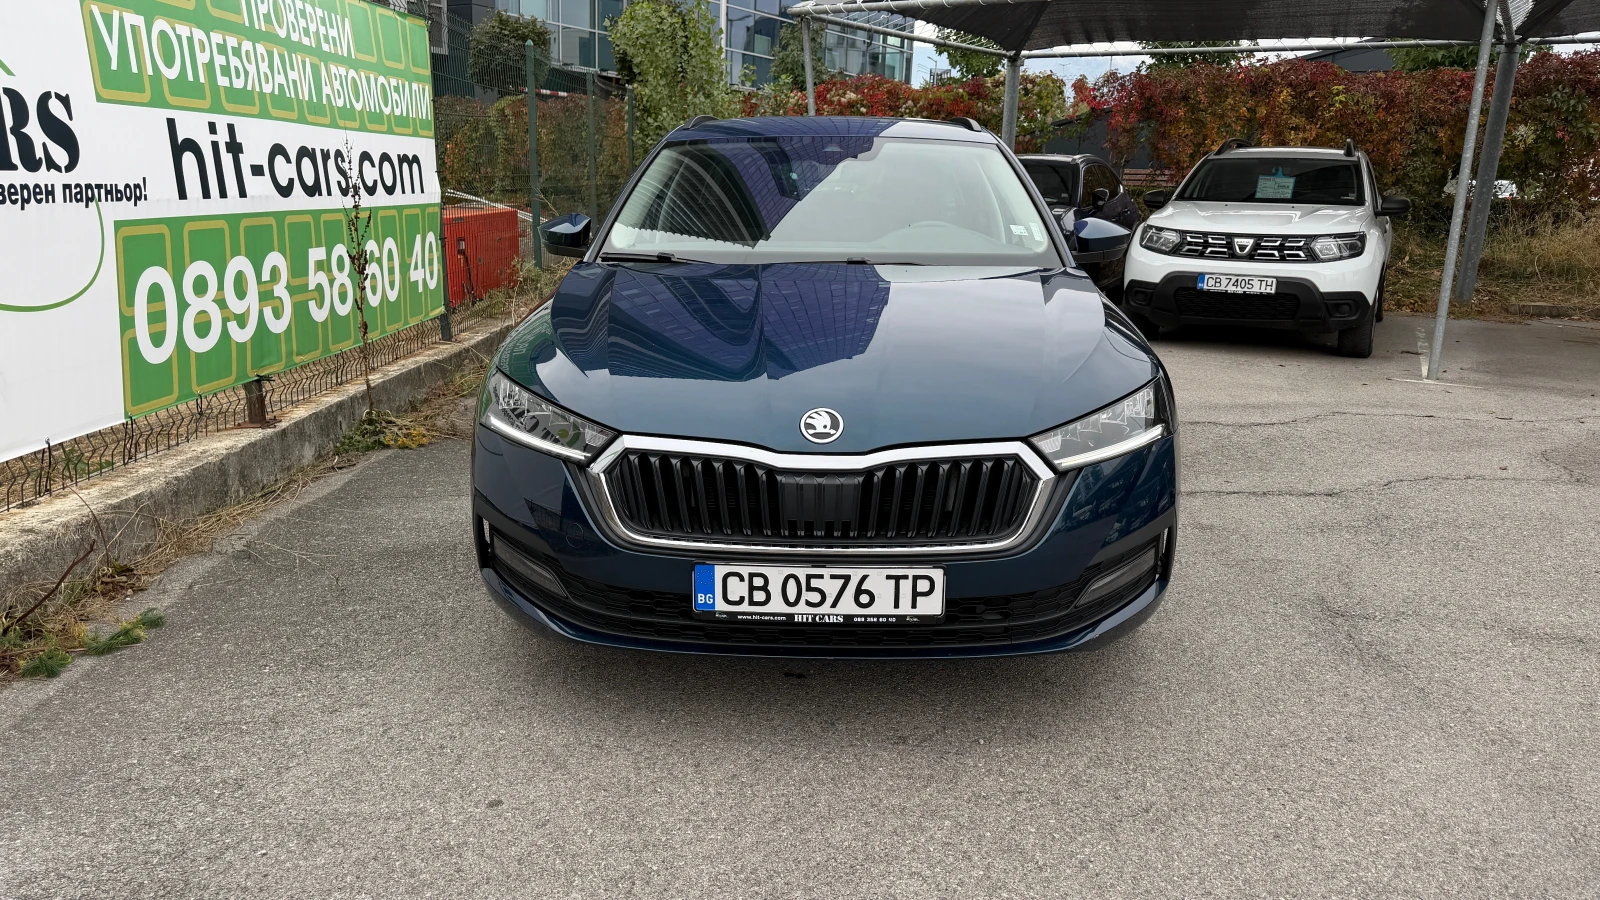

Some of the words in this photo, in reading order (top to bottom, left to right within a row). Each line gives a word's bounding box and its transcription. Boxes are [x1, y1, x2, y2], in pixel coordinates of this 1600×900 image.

[242, 0, 355, 59] ПРОВЕРЕНИ
[91, 4, 317, 103] УПОТРЕБЯВАНИ
[321, 62, 431, 120] АВТОМОБИЛИ
[62, 177, 148, 208] партньор!
[134, 251, 292, 365] 0893
[308, 243, 354, 323] 58
[364, 236, 400, 308] 60
[410, 231, 438, 293] 40
[1206, 276, 1222, 288] CB
[1224, 278, 1255, 290] 7405
[1258, 279, 1274, 291] TH
[697, 593, 714, 604] BG
[721, 571, 772, 606] CB
[780, 573, 876, 609] 0576
[885, 574, 936, 609] TP
[794, 614, 814, 622] HIT
[816, 614, 844, 623] CARS
